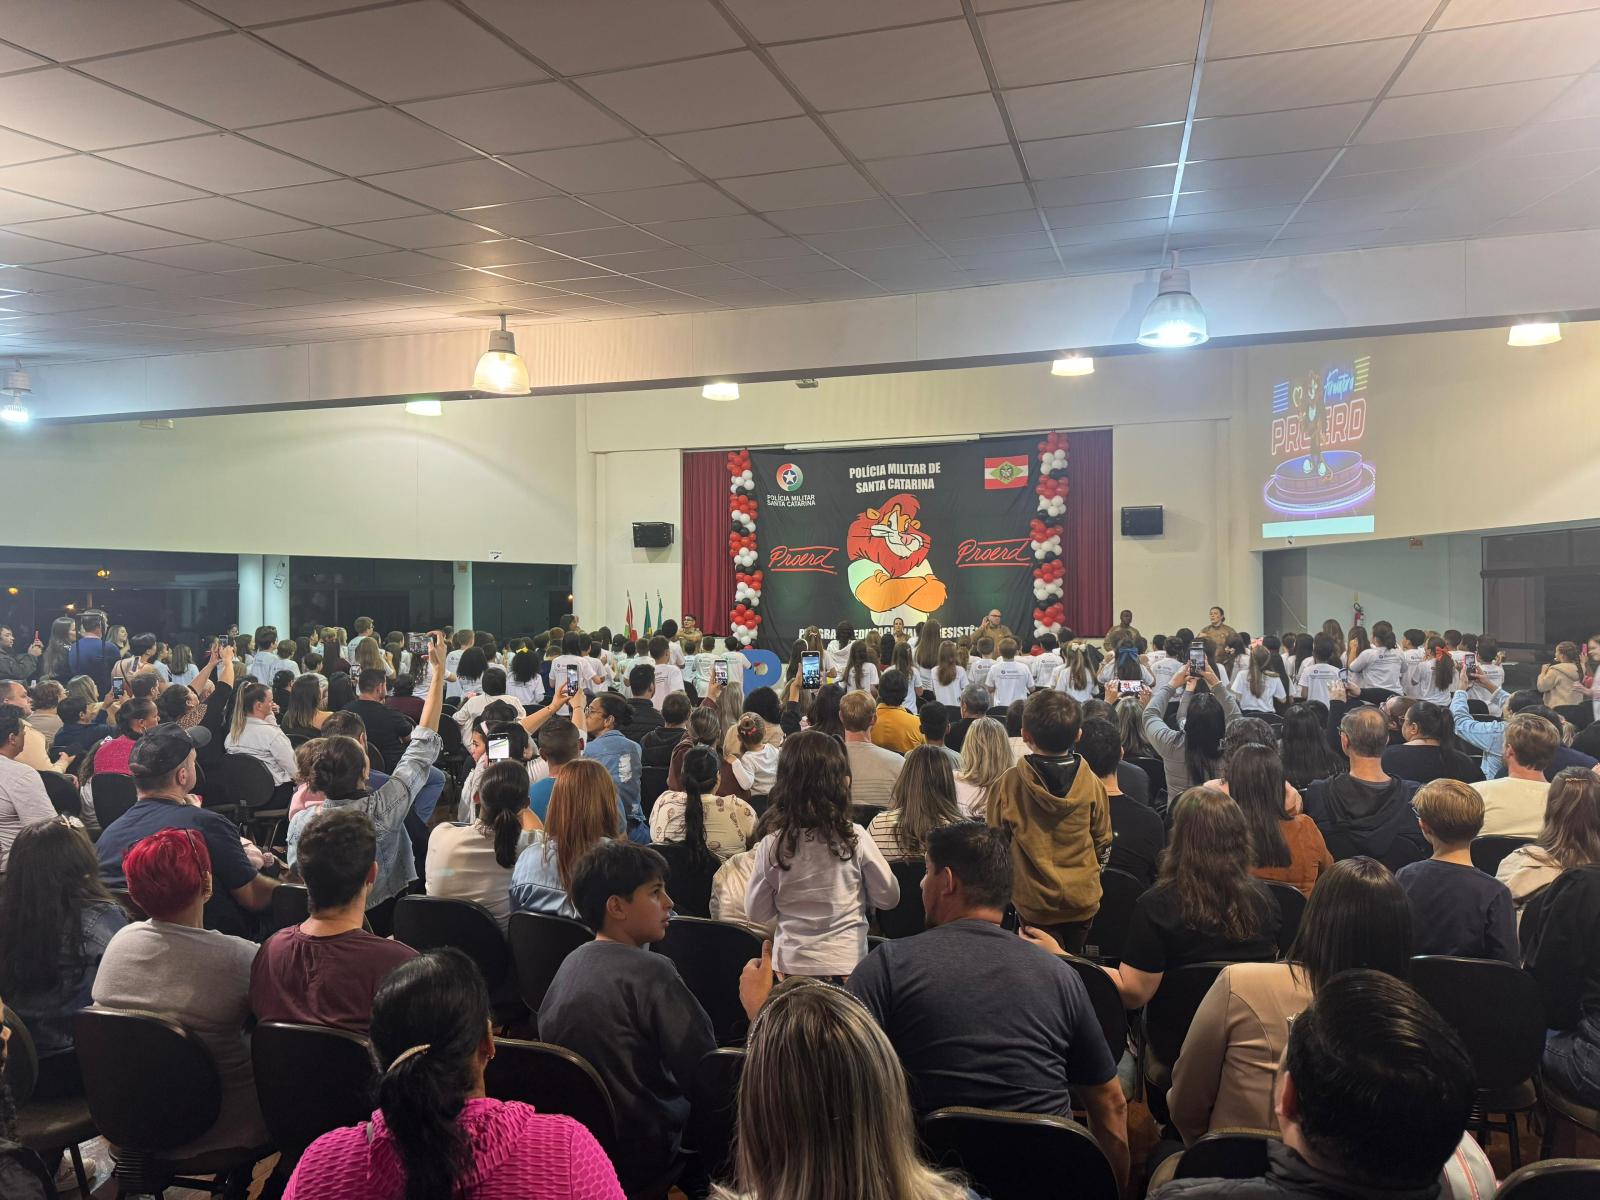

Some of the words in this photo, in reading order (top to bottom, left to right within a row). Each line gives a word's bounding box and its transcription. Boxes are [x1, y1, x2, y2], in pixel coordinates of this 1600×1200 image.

[849, 464, 886, 479] POLÍCIA
[887, 462, 927, 475] MILITAR
[928, 462, 941, 474] DE
[855, 479, 886, 494] SANTA
[887, 478, 935, 490] CATARINA
[768, 545, 840, 575] Proerd
[955, 538, 1033, 567] Proerd
